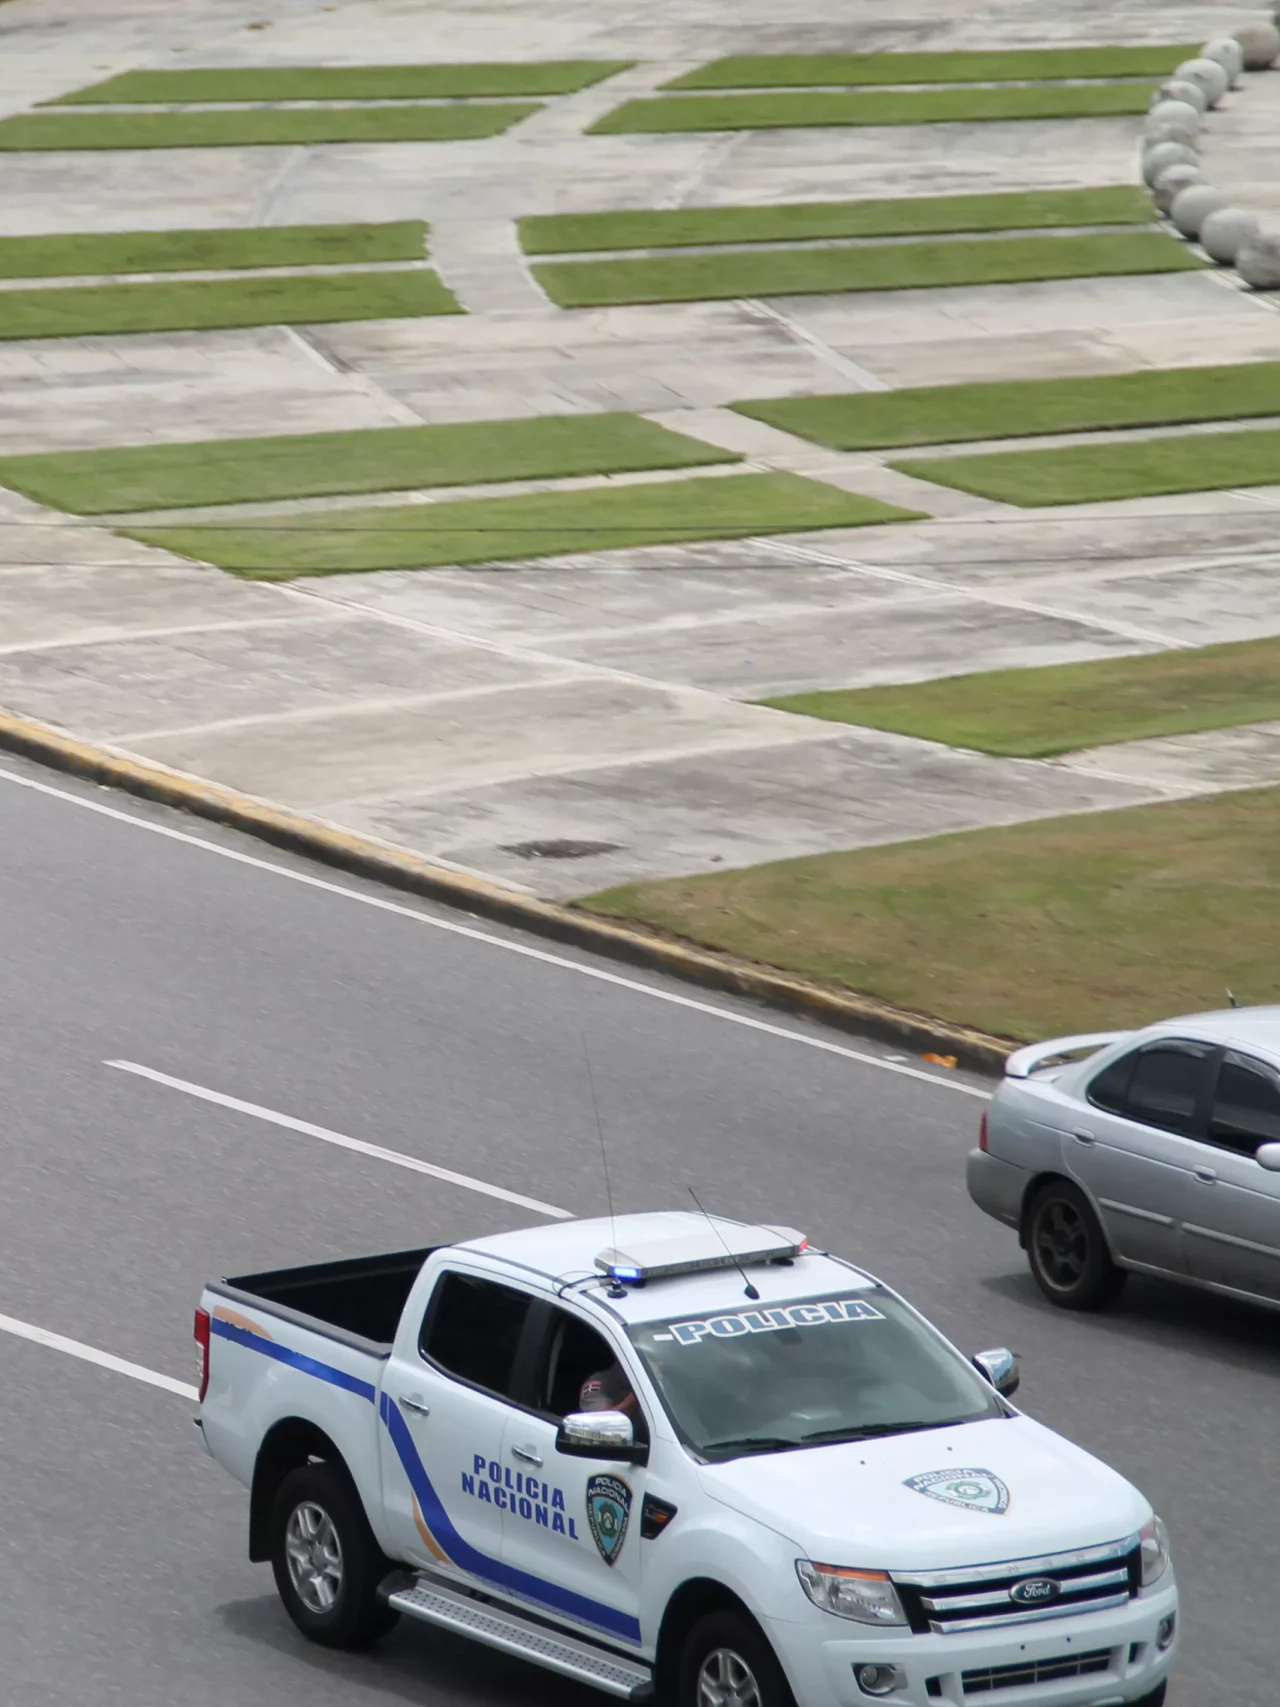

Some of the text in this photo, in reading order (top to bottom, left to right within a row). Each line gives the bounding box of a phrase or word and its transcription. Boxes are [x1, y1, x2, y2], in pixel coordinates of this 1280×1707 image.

[473, 1453, 566, 1513] POLICIA
[595, 1477, 627, 1498] POLICIA
[912, 1468, 975, 1483] POLICIA
[461, 1471, 579, 1541] NACIONAL
[587, 1486, 629, 1513] NACIONAL
[1023, 1581, 1052, 1599] Ford
